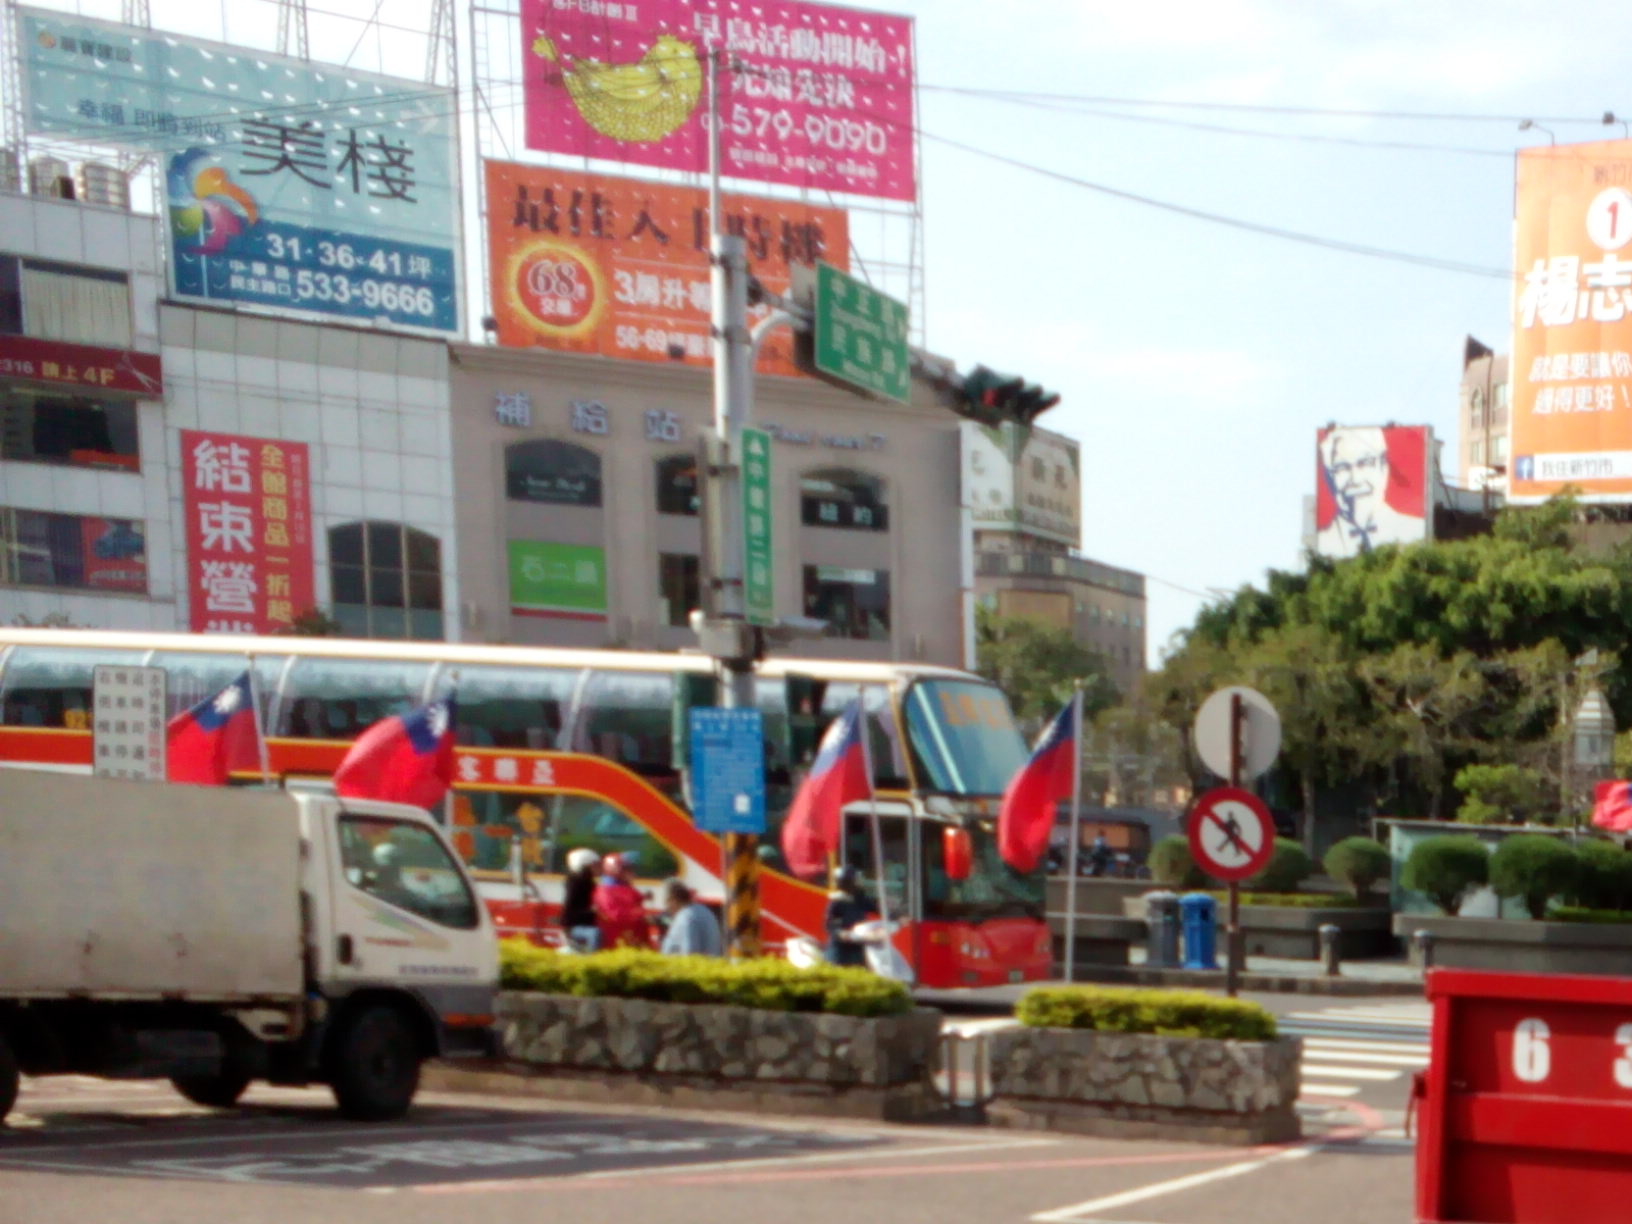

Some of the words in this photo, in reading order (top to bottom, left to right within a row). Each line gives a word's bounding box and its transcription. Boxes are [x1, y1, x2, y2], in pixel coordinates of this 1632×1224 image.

[239, 116, 418, 204] 美棧
[1604, 200, 1620, 240] 1
[296, 269, 435, 316] 533-9666
[1512, 1018, 1552, 1083] 6
